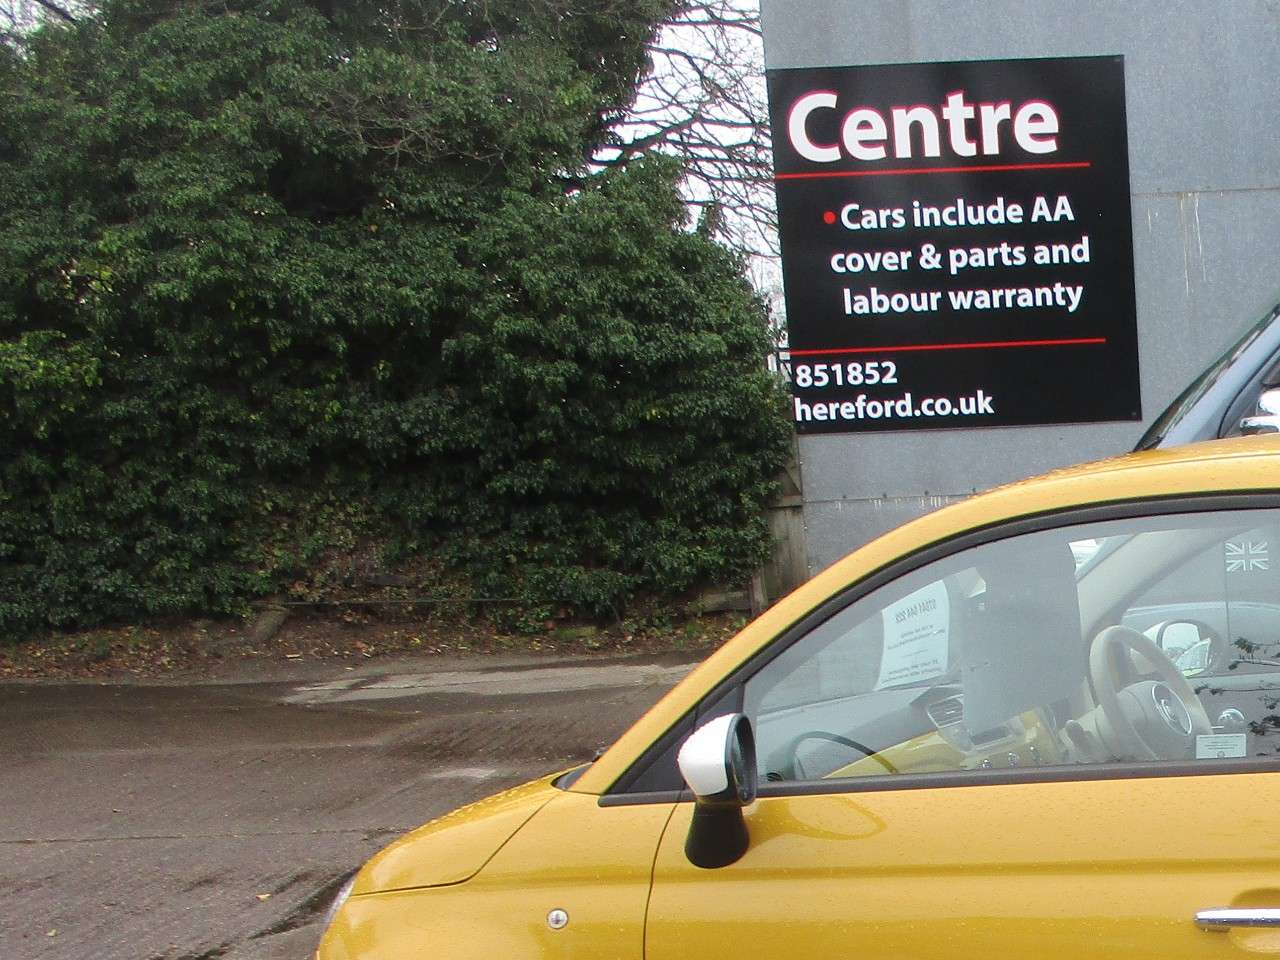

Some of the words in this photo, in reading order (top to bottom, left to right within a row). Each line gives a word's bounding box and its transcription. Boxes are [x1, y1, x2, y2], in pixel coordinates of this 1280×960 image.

[787, 92, 1060, 163] Centre
[840, 203, 906, 231] Cars
[912, 197, 1025, 228] include
[1031, 195, 1075, 223] AA
[830, 249, 912, 275] cover
[919, 243, 943, 271] &
[949, 244, 1027, 275] parts
[1033, 236, 1090, 264] and
[843, 288, 942, 315] labour
[948, 282, 1084, 314] warranty
[795, 361, 898, 388] 851852
[794, 390, 995, 422] hereford.co.uk
